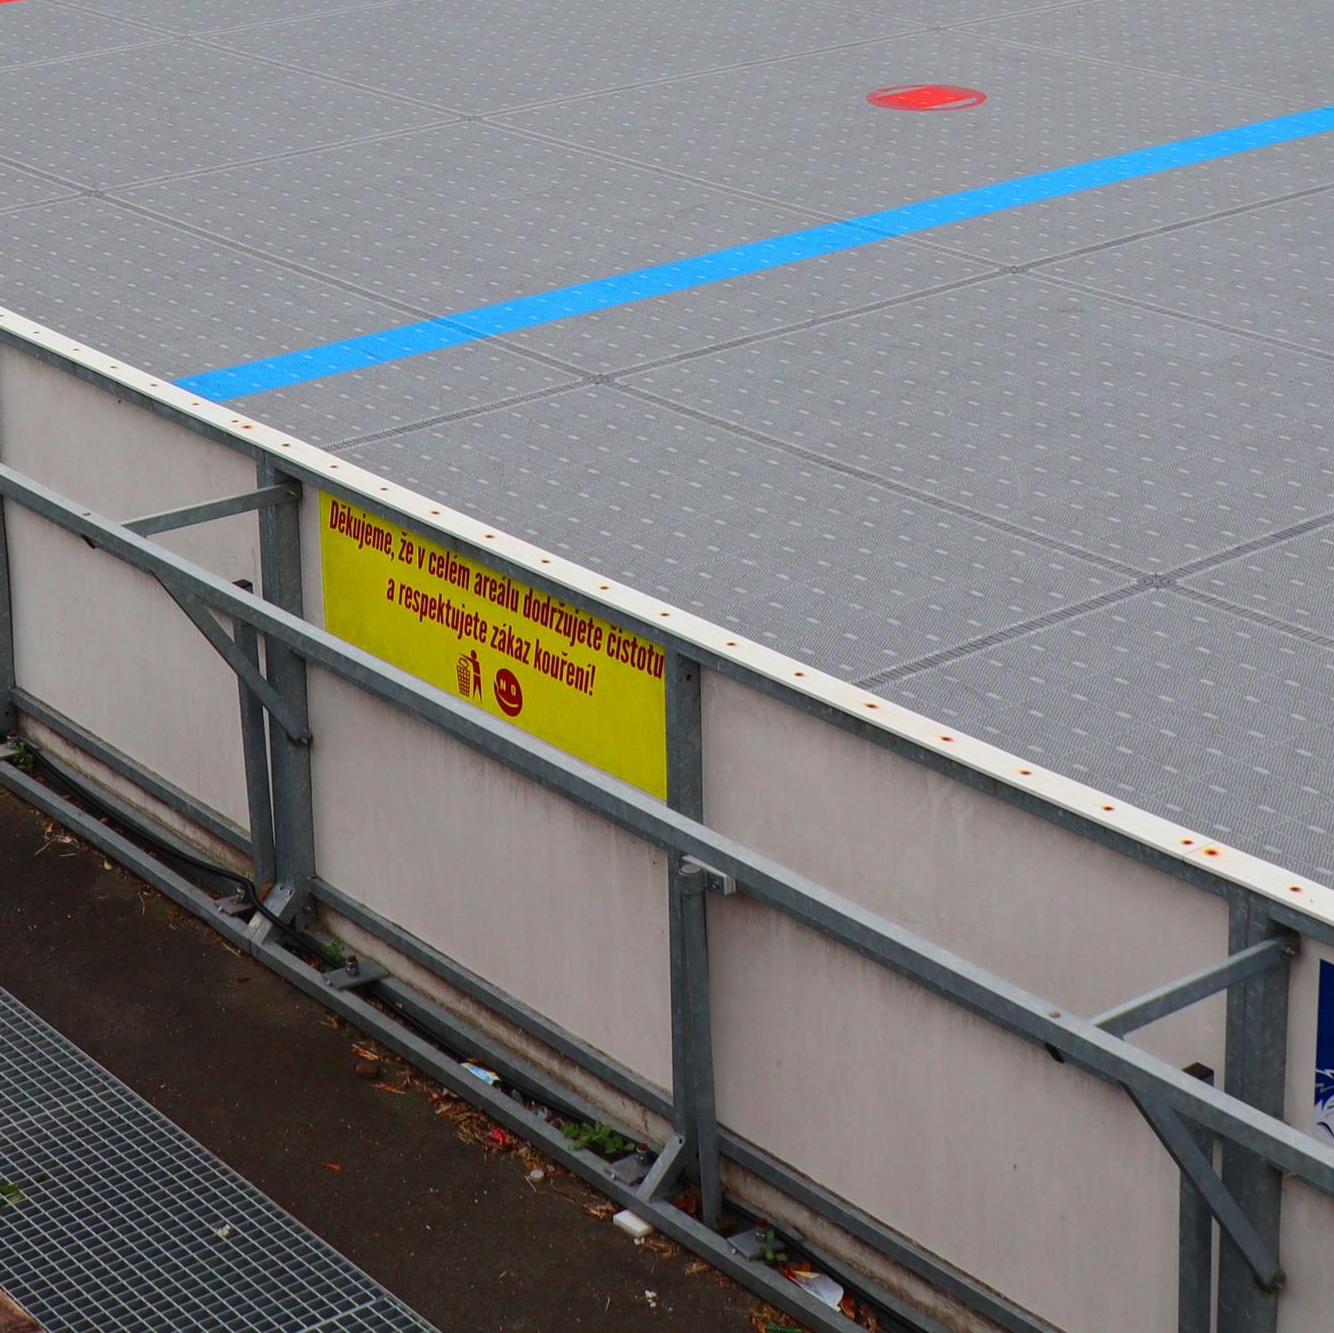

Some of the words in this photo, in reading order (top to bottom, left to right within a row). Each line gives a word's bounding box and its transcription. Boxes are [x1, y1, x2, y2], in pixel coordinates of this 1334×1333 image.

[329, 499, 395, 562] Děkujeme,
[397, 530, 414, 565] že
[417, 546, 426, 570] v
[428, 550, 471, 591] celém
[473, 571, 519, 614] areálu
[522, 587, 603, 652] dodržujete
[606, 623, 665, 680] čistotu
[386, 578, 396, 602] a
[398, 582, 488, 644] respektujete
[490, 622, 532, 666] zákaz
[533, 638, 597, 697] kouření!
